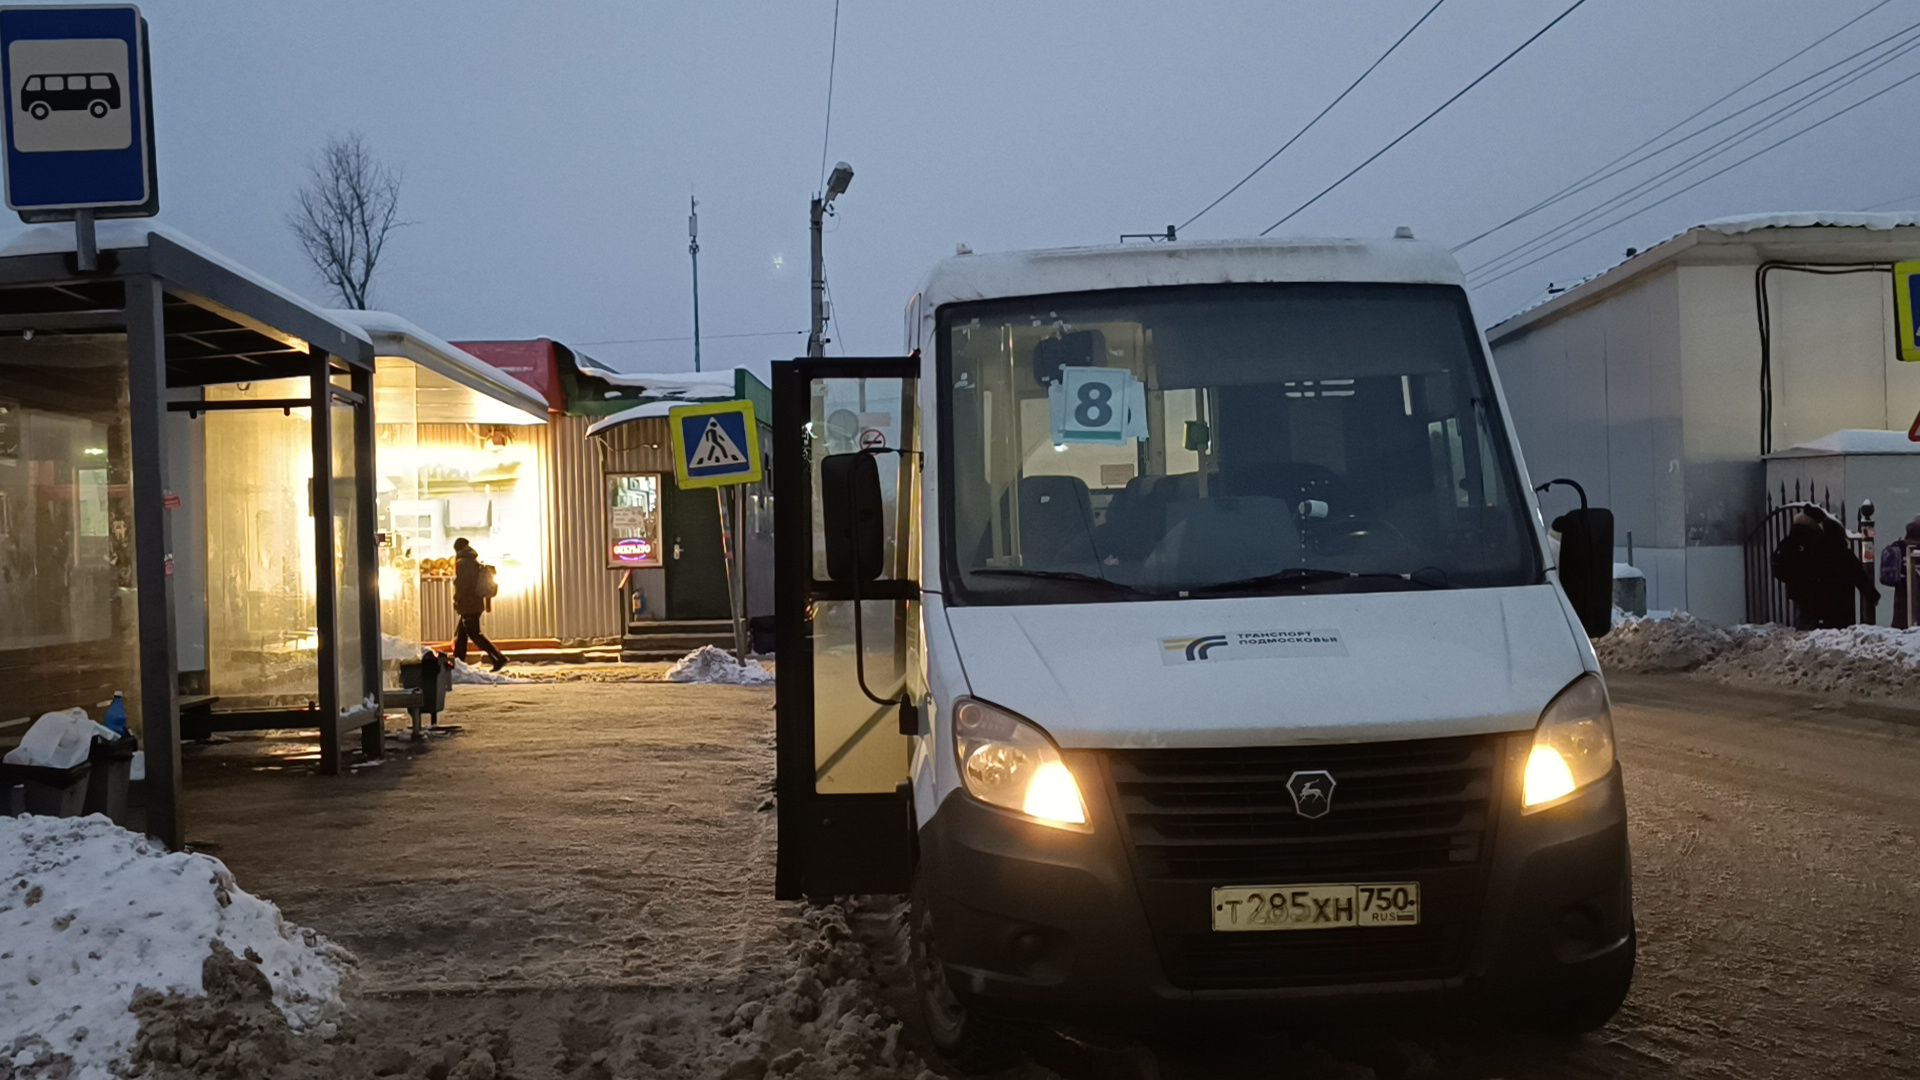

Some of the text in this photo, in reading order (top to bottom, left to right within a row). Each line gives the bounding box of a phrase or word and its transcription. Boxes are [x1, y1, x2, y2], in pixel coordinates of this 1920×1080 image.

[1075, 382, 1112, 427] 8
[1238, 631, 1311, 639] ТРАНСПОРТ
[1239, 637, 1338, 645] ПОДМОСКОВЬЯ
[1360, 888, 1409, 911] 750
[1372, 912, 1396, 921] RUS
